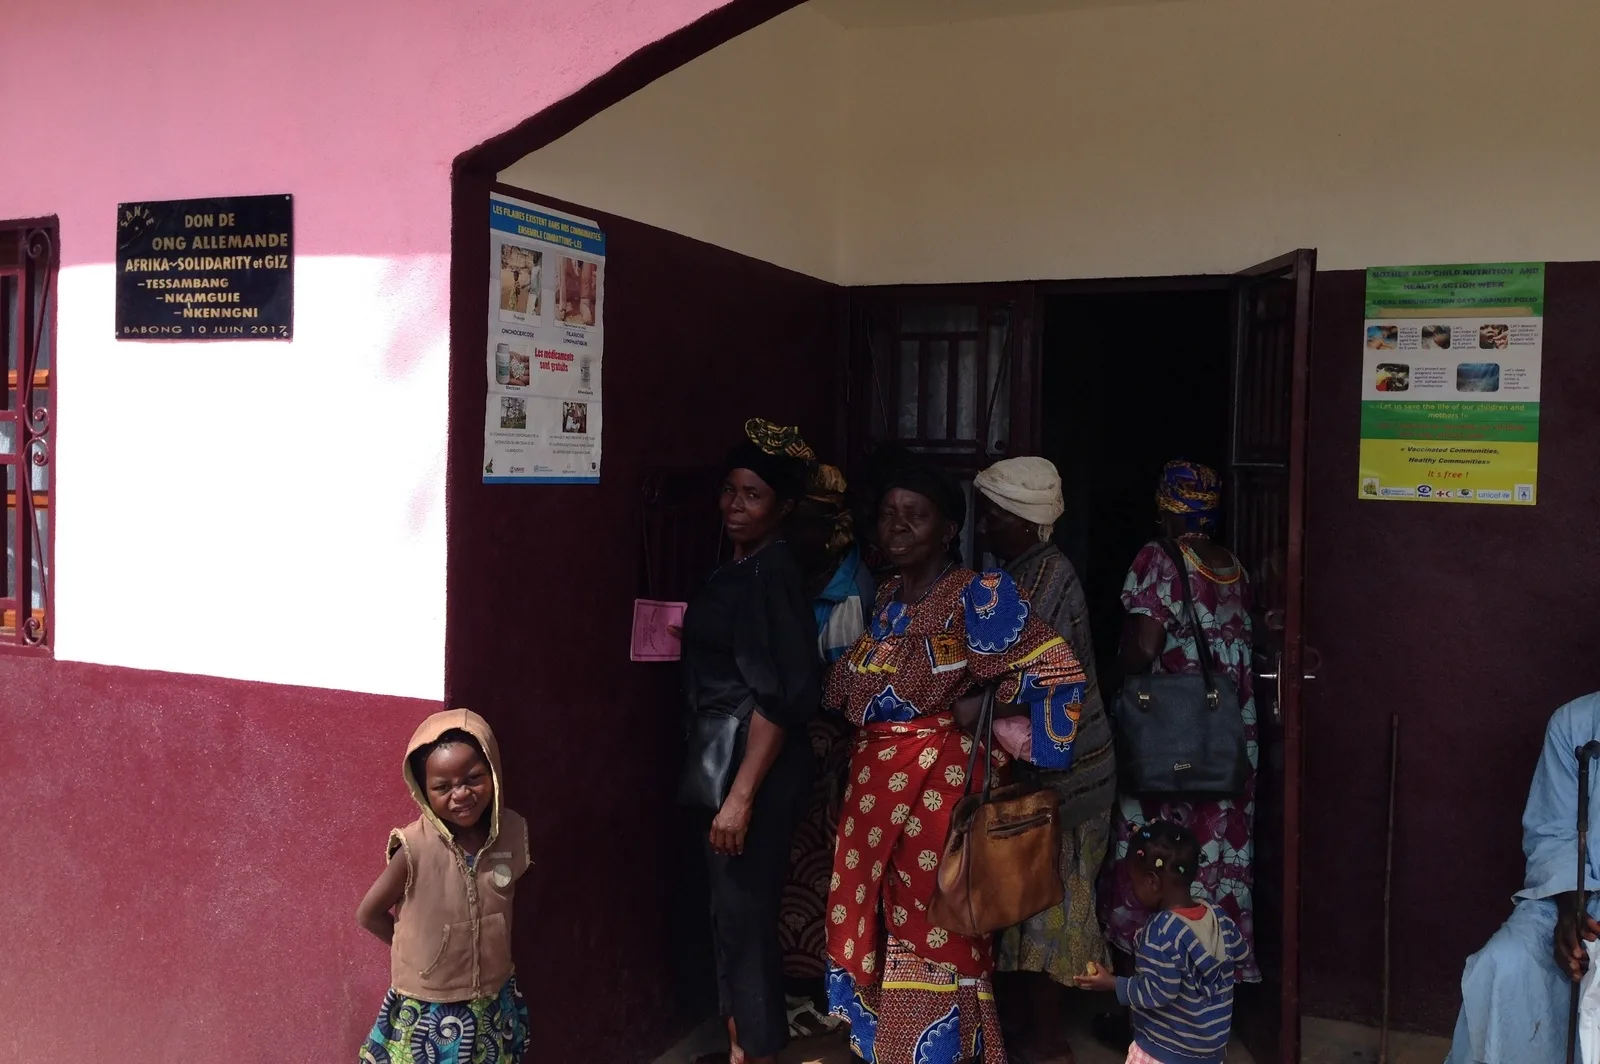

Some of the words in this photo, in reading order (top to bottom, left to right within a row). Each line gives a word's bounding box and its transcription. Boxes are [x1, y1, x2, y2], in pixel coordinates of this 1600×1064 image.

[492, 204, 503, 214] LES
[526, 214, 548, 227] EXISTENT
[185, 214, 213, 228] DON
[219, 213, 235, 227] DE
[152, 237, 187, 251] ONG
[192, 233, 288, 250] ALLEMANDE
[253, 258, 263, 269] et
[264, 255, 288, 269] GIZ
[1433, 269, 1459, 277] CHILD
[1463, 267, 1513, 276] NUTRITION
[1519, 267, 1539, 275] AND
[1403, 282, 1438, 290] HEALTH
[1441, 281, 1476, 290] ACTION
[1478, 281, 1505, 289] WEEK
[1398, 298, 1455, 306] IMMUNIZATION
[124, 325, 183, 334] BABONG
[191, 325, 207, 334] 10
[212, 325, 243, 334] JUIN
[251, 325, 288, 334] 2017
[535, 348, 543, 358] Les
[1428, 411, 1459, 419] mothers
[1408, 457, 1437, 465] Healthy
[1443, 470, 1463, 479] free
